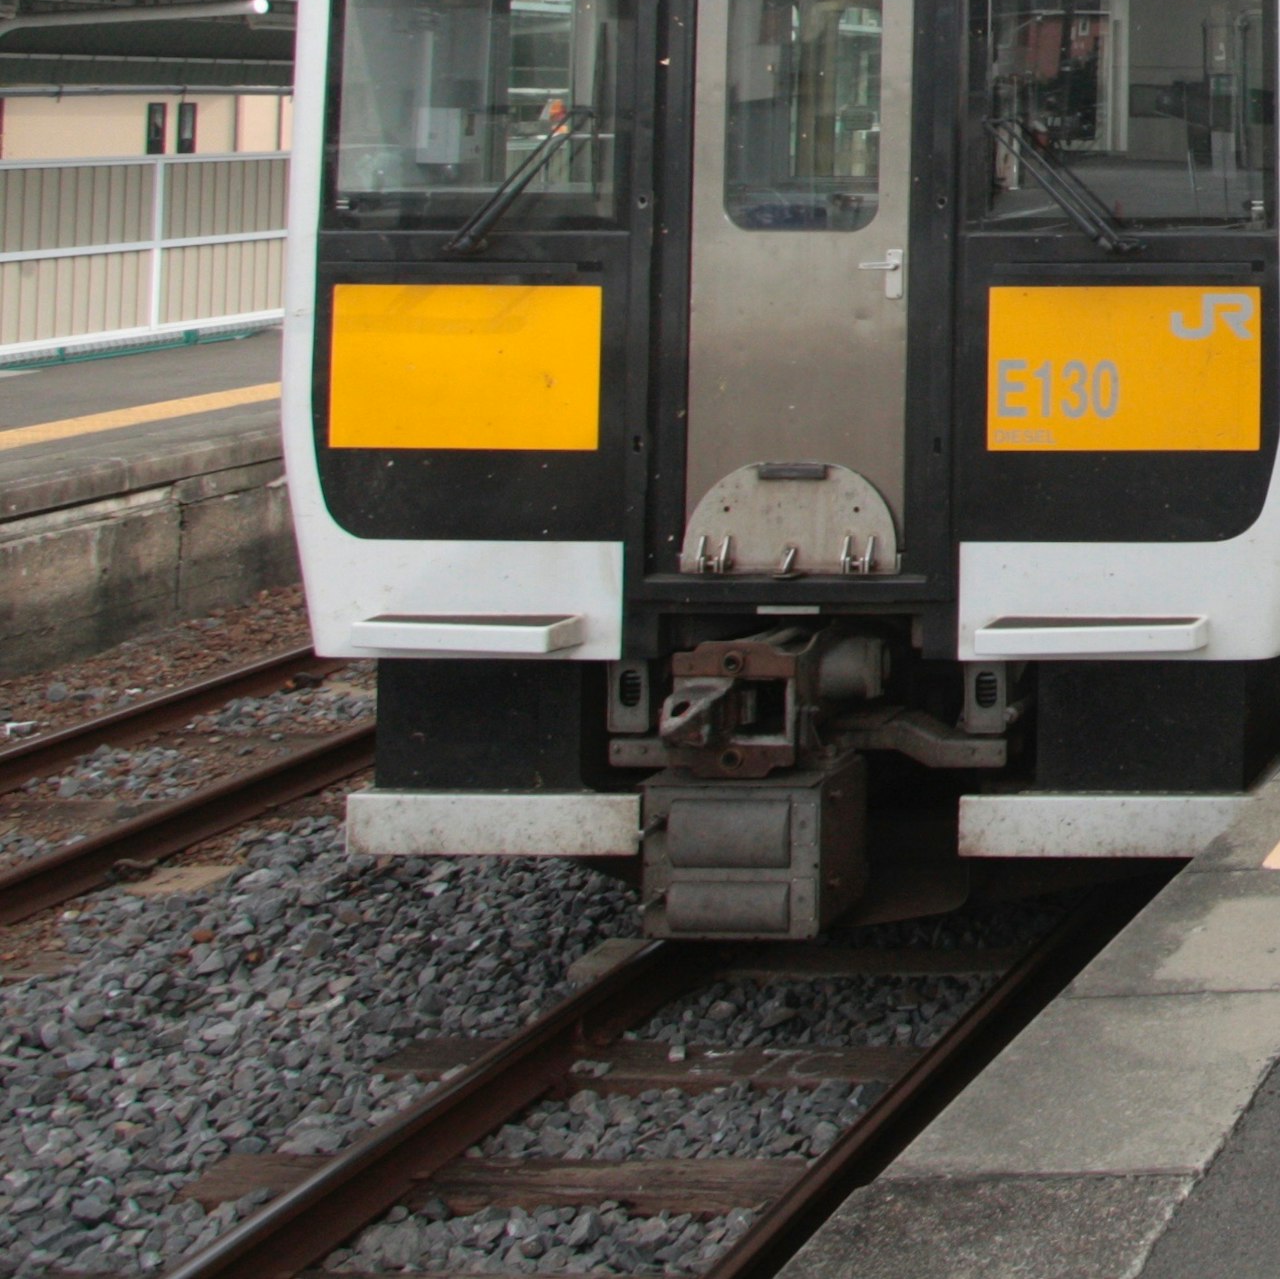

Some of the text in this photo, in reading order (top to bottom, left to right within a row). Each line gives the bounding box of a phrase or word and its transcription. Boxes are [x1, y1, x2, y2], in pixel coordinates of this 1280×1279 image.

[1170, 292, 1255, 340] JR
[996, 359, 1120, 419] E130
[994, 429, 1056, 444] DIESEL
